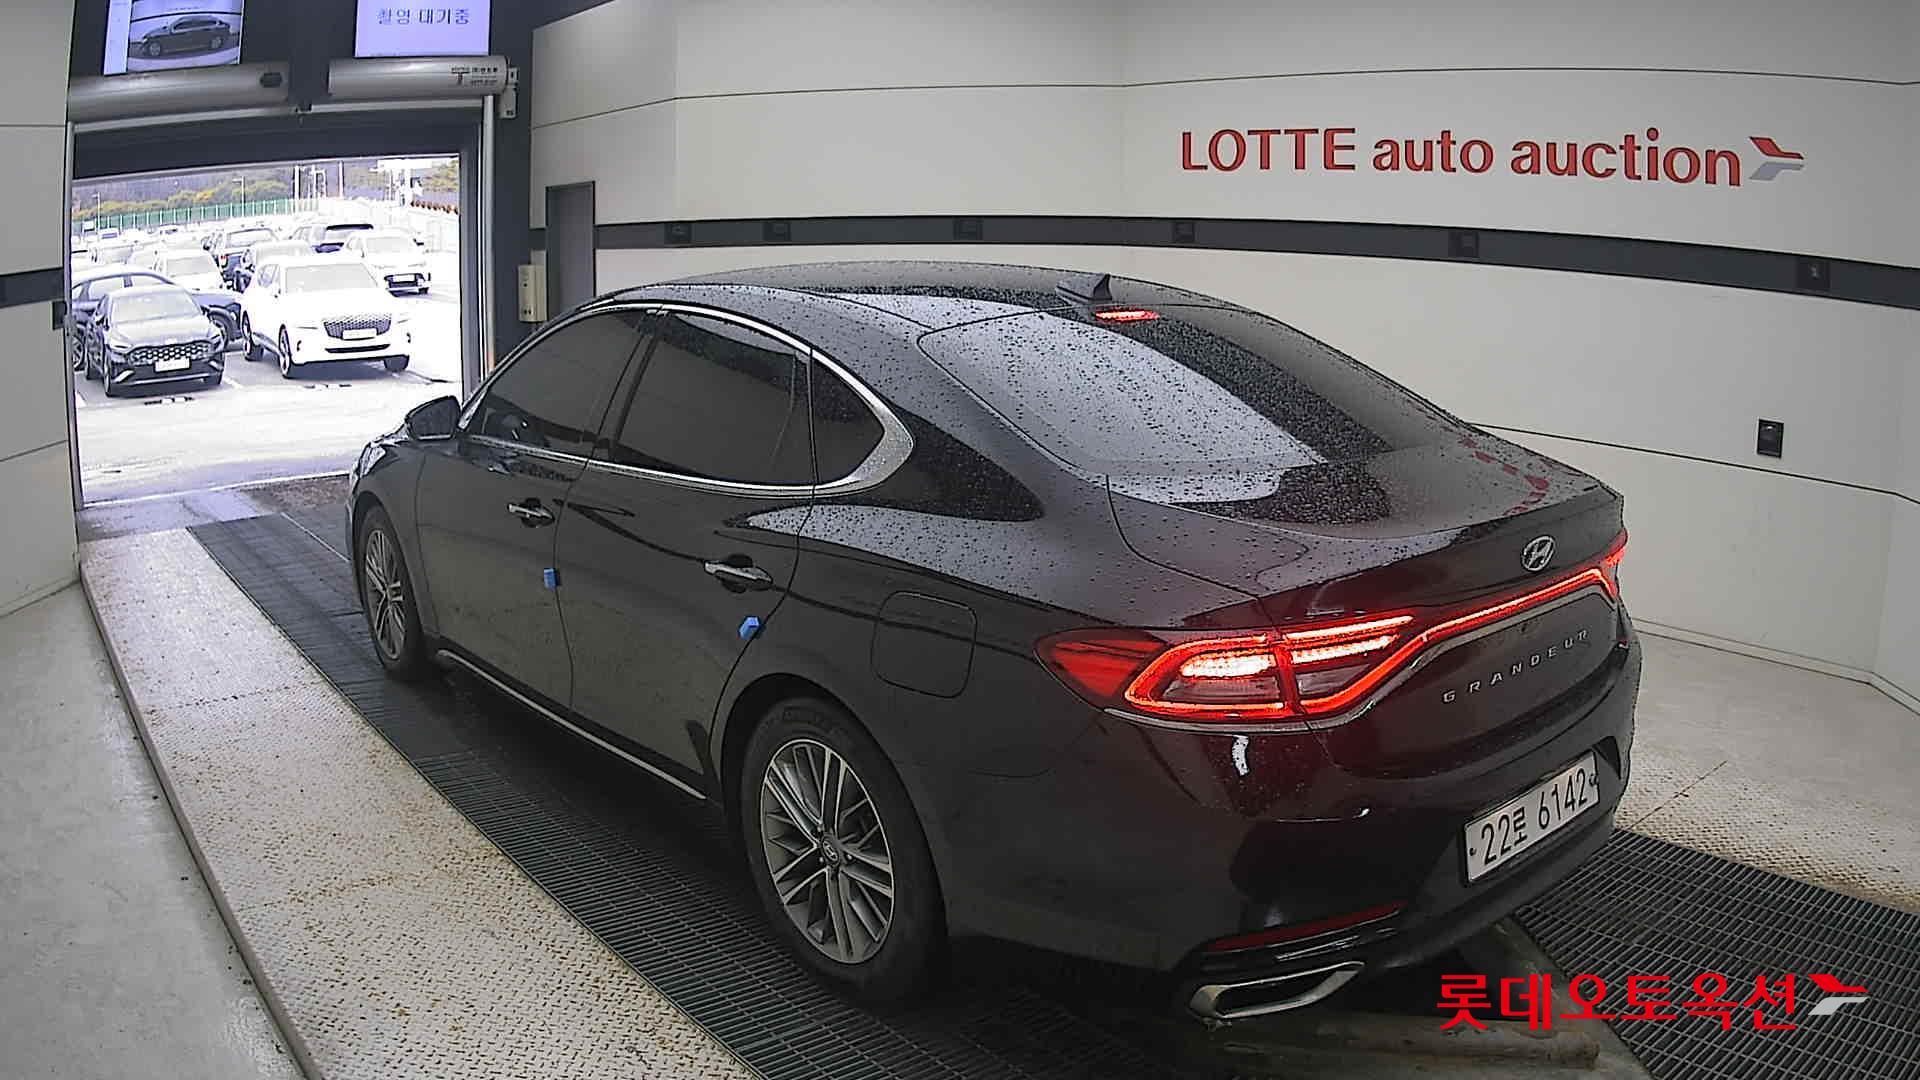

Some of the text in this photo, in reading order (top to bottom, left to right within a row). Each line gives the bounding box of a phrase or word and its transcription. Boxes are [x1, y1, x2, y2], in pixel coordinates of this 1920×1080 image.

[418, 7, 470, 25] 대기중
[1181, 127, 1741, 187] LOTTE auto auction
[1442, 629, 1588, 704] GRANDEUR
[1481, 767, 1588, 865] 22로 6142
